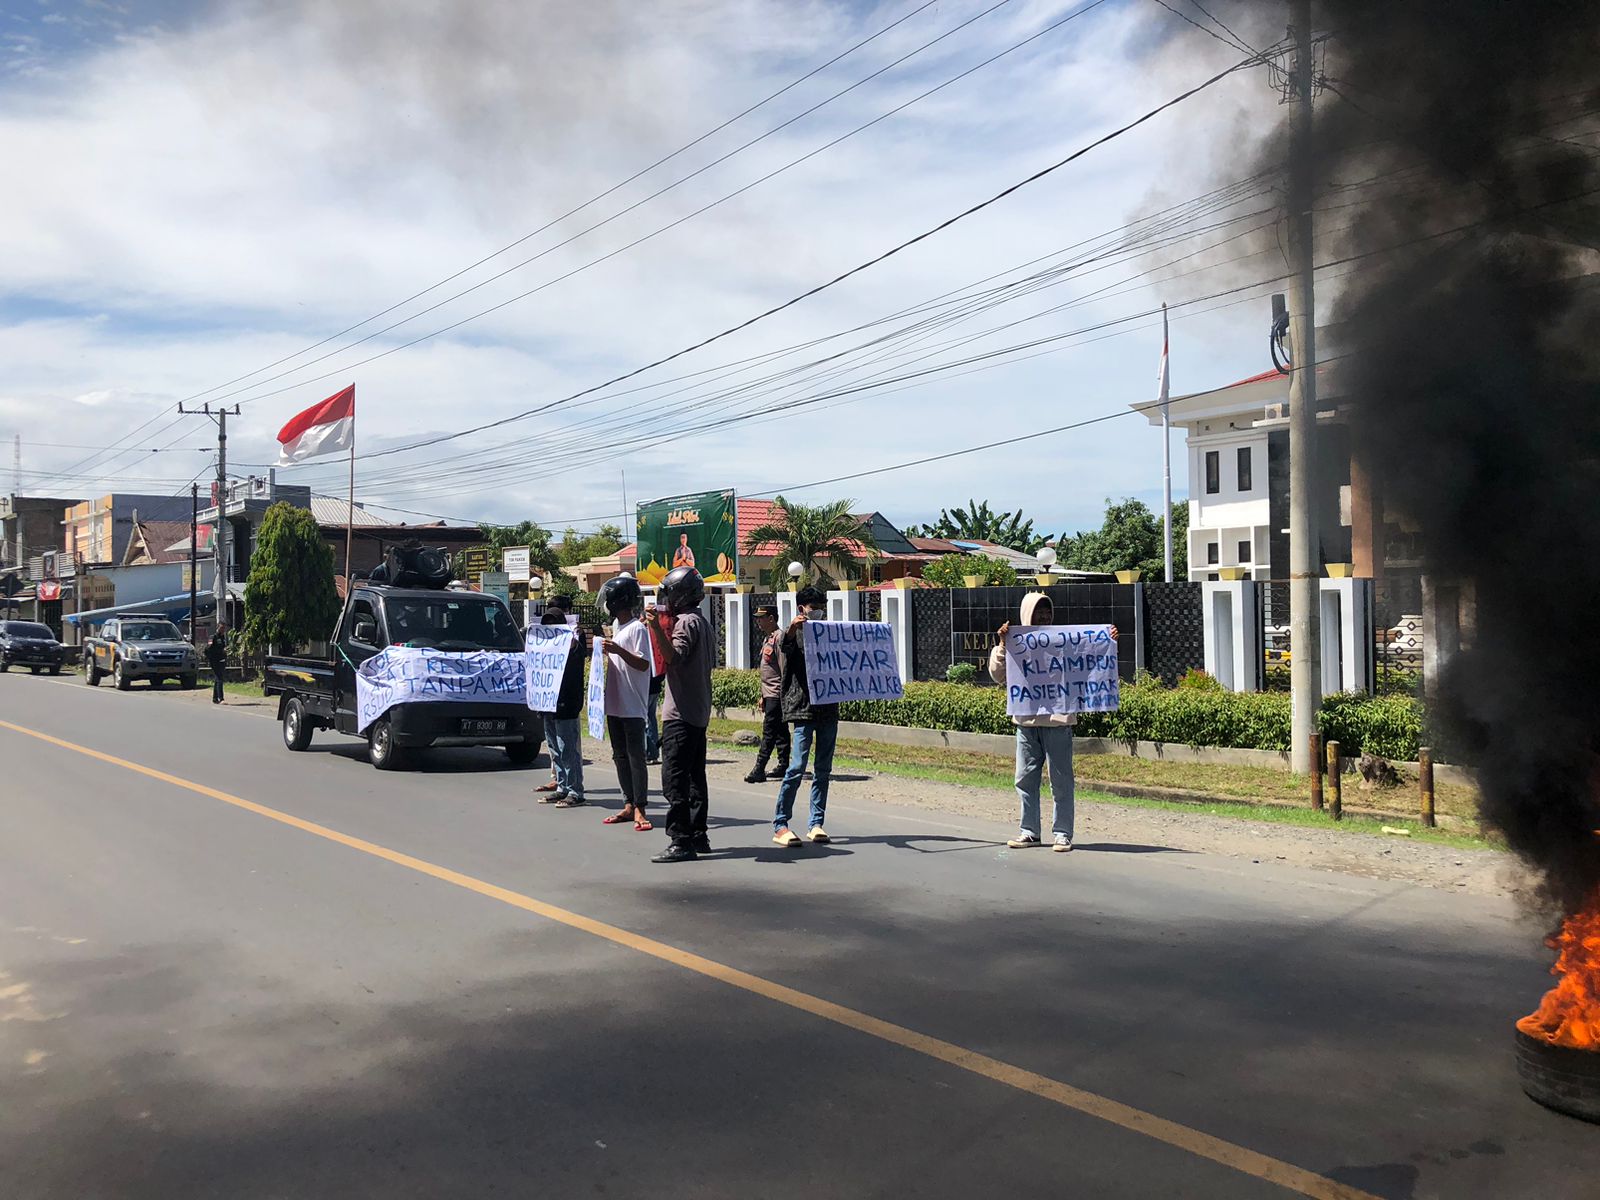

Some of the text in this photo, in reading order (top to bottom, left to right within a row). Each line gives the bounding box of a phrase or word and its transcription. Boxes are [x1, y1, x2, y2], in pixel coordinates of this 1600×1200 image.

[812, 622, 892, 645] PULUHAN
[964, 633, 998, 650] KEJA
[1013, 629, 1111, 655] 300 JUTA
[816, 649, 893, 672] MILYAR
[1022, 656, 1083, 677] KLAIM
[531, 670, 554, 688] RSUD
[868, 675, 901, 695] ALKE
[363, 676, 526, 721] RSUD TANPA MER
[1010, 679, 1117, 703] PASIEN TIDAK
